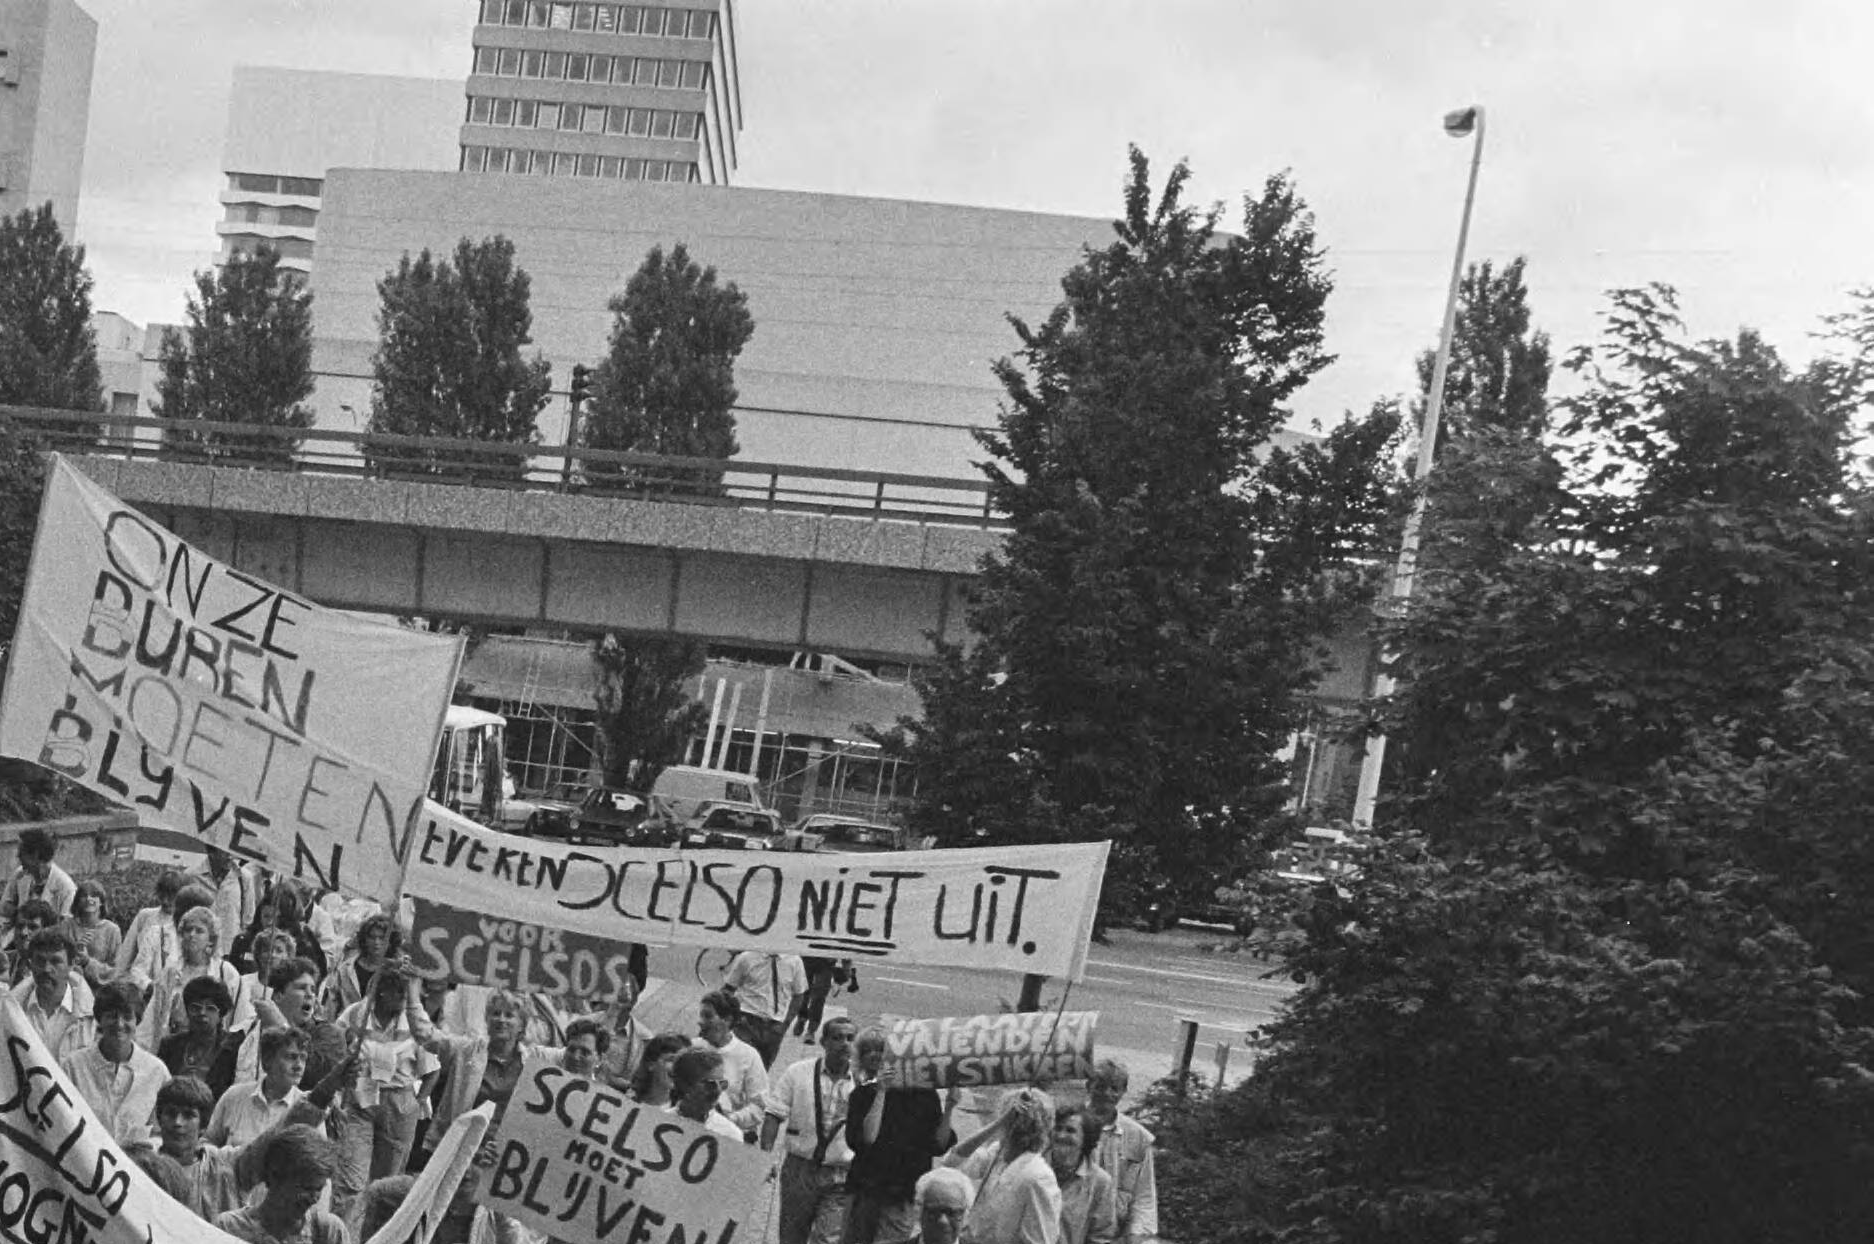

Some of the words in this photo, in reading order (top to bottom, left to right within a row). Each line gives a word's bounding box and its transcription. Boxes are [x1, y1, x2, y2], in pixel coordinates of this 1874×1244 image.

[104, 511, 313, 660] ONZE
[82, 570, 315, 737] BUREN
[66, 647, 427, 867] MOETEN
[479, 917, 565, 952] VOOR
[556, 851, 784, 935] SCELSO
[797, 868, 925, 940] NIET
[934, 865, 1061, 955] UIT.
[417, 926, 627, 1001] SCELSOS
[526, 1067, 720, 1184] SCELSO
[564, 1139, 645, 1189] MOET
